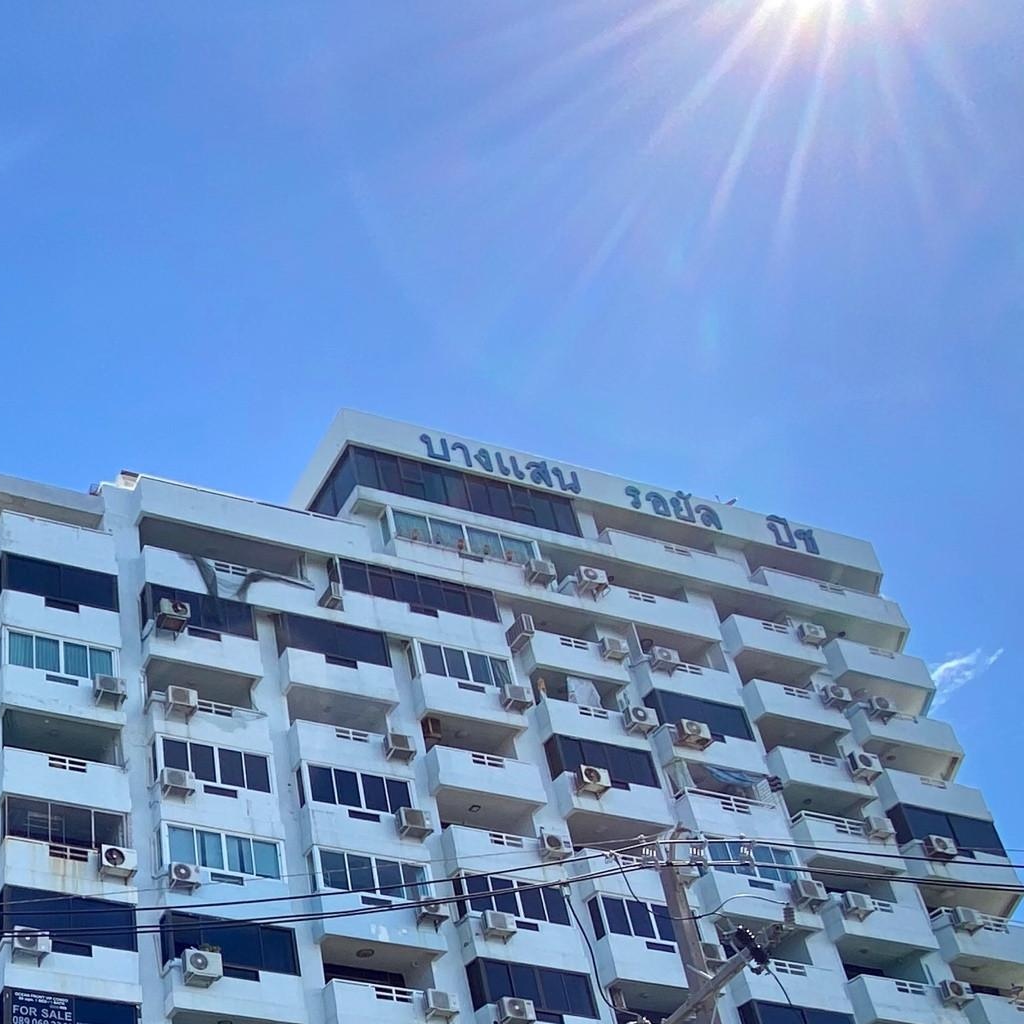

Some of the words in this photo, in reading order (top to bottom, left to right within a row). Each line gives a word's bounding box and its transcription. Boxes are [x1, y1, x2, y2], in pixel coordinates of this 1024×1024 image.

[420, 433, 582, 494] บางแสน
[624, 485, 723, 530] รอยัล
[12, 1004, 38, 1017] FOR
[41, 1008, 72, 1021] SALE
